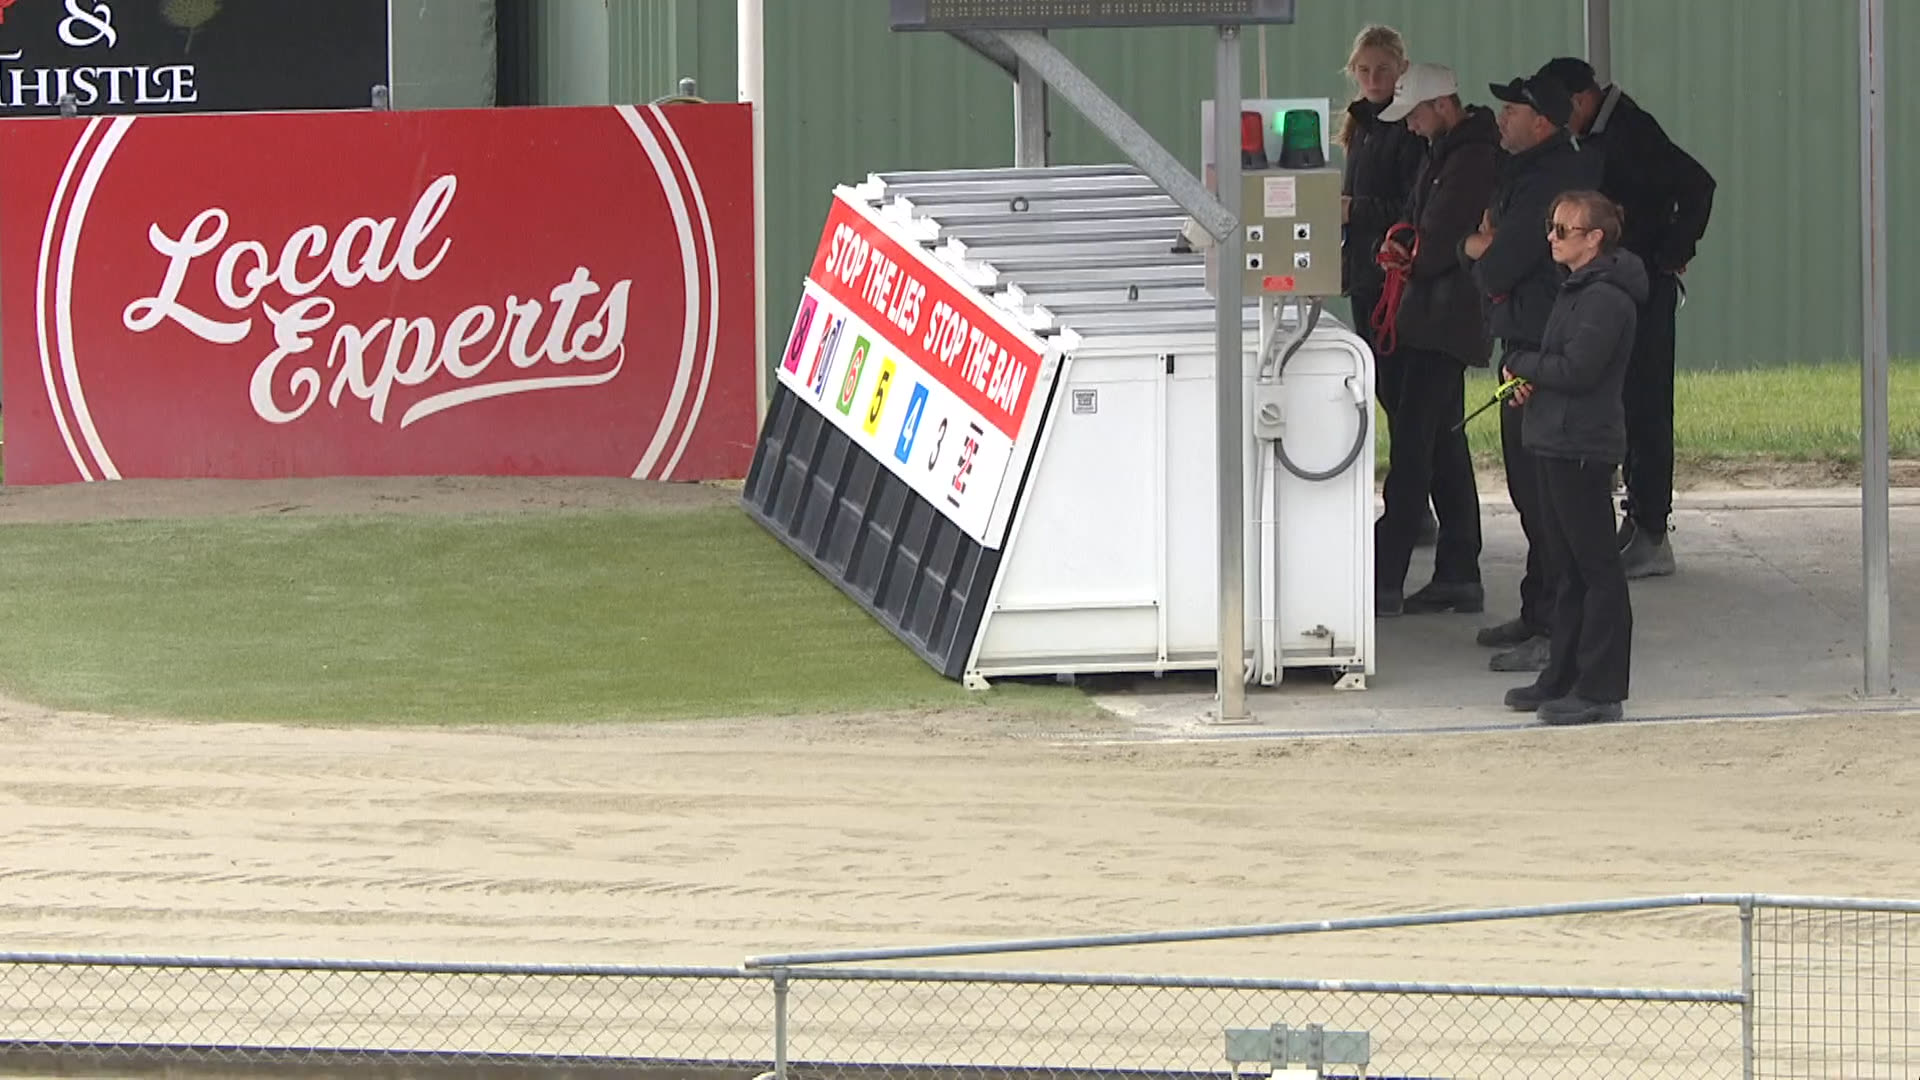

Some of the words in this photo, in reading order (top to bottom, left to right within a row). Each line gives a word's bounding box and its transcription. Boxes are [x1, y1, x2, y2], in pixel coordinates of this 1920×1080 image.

[57, 0, 118, 48] &
[122, 174, 457, 344] Local
[825, 222, 870, 289] STOP
[861, 247, 898, 314] THE
[887, 268, 926, 336] LIES
[923, 300, 969, 368] STOP
[961, 326, 998, 393] THE
[986, 347, 1027, 416] BAN
[249, 266, 632, 428] Experts
[791, 307, 811, 361] 8
[842, 346, 865, 406] 6
[870, 370, 890, 424] 5
[902, 396, 922, 459] 4
[928, 417, 948, 471] 3
[954, 438, 974, 491] 2
